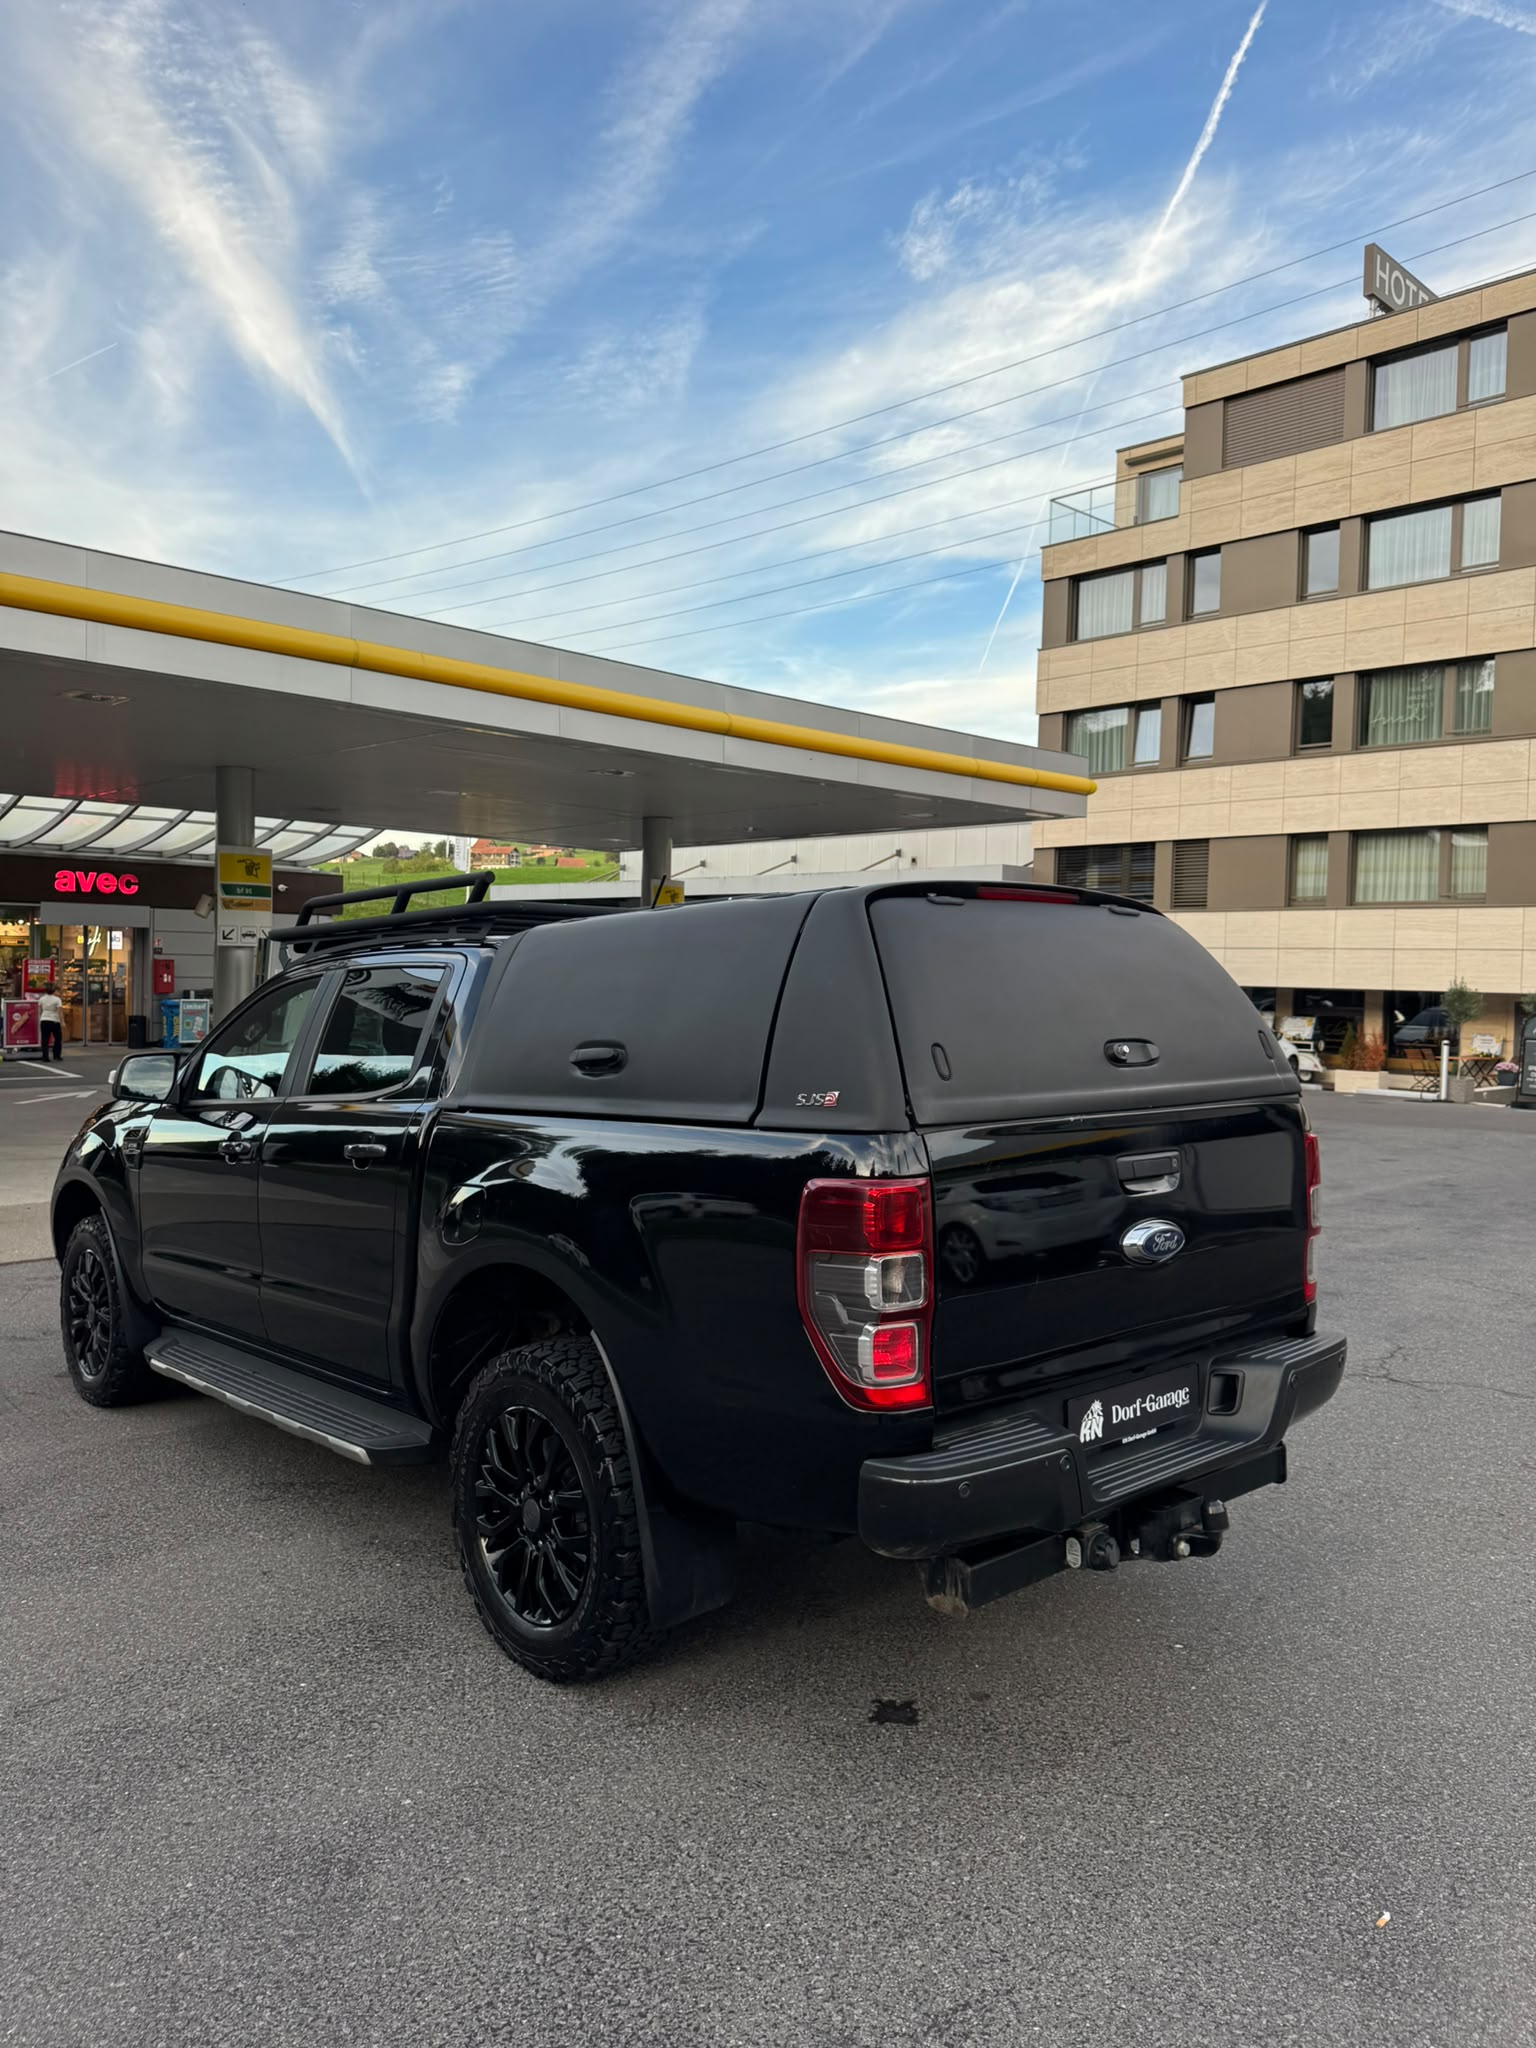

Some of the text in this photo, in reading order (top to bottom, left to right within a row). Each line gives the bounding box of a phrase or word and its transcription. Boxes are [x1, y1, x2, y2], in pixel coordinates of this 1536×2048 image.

[54, 869, 139, 895] avec
[1152, 1232, 1178, 1253] Ford
[1111, 1386, 1190, 1424] Dorf-Garage
